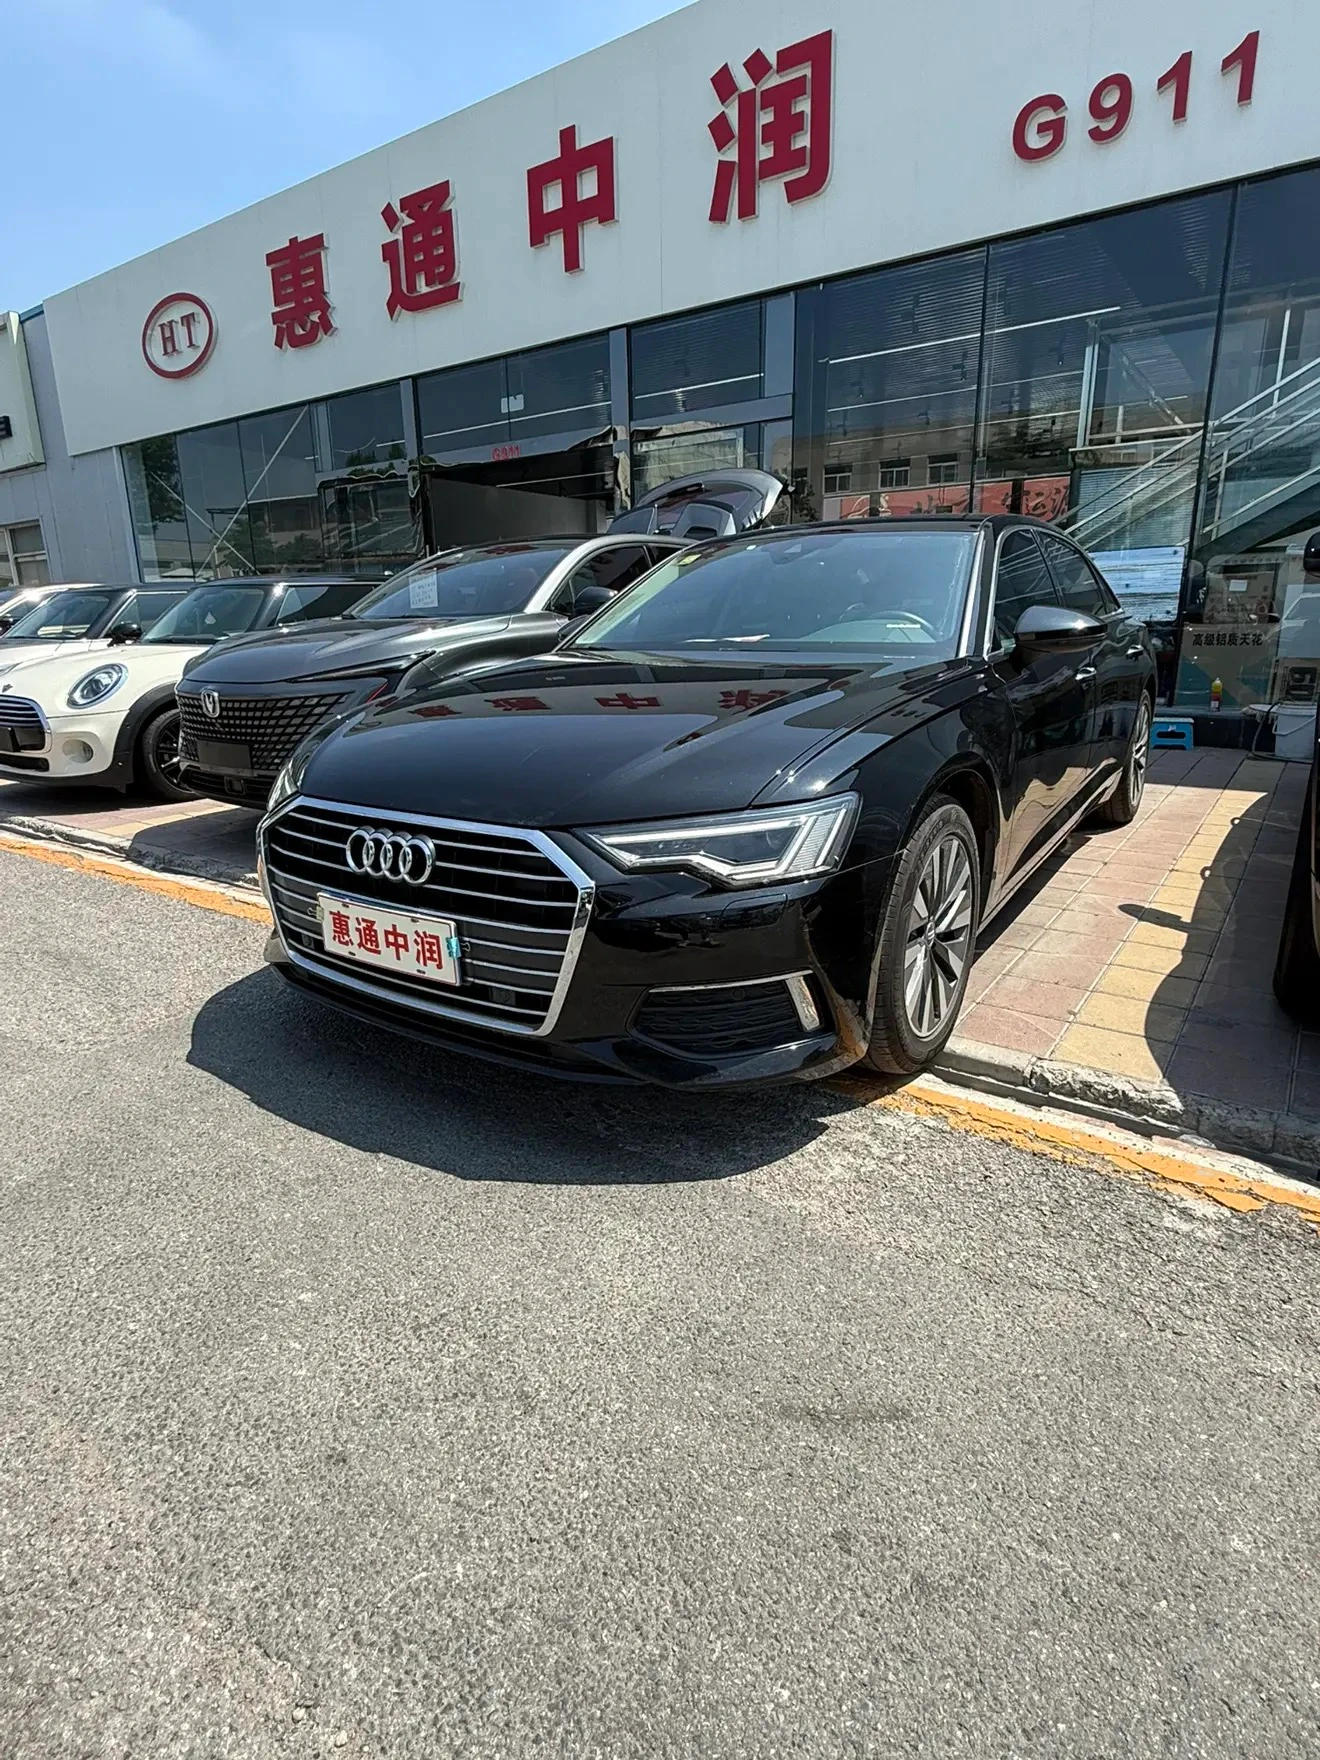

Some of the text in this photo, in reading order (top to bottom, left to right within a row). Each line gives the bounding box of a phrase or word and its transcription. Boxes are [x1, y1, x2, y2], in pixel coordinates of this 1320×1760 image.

[1013, 32, 1260, 162] G911
[266, 31, 835, 348] 惠通中润
[159, 312, 198, 356] HT
[329, 909, 445, 970] 惠通中润
